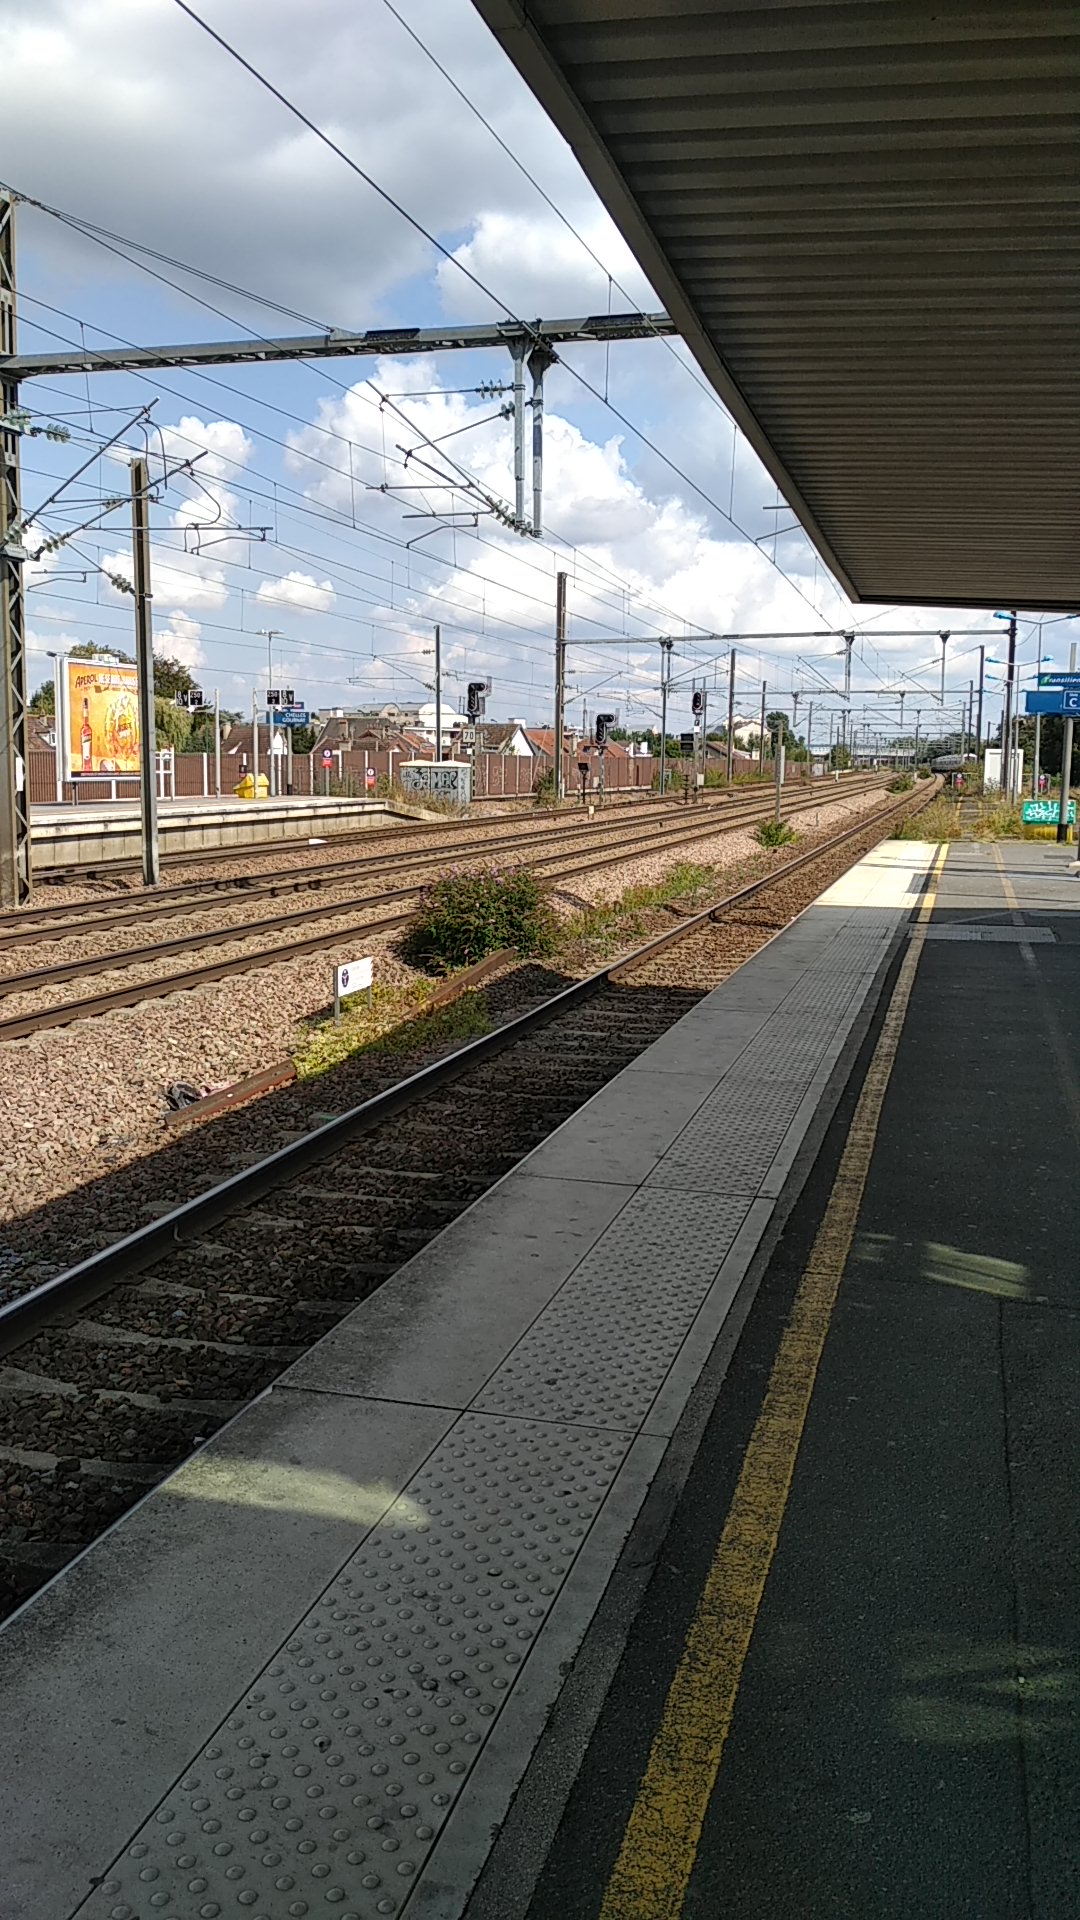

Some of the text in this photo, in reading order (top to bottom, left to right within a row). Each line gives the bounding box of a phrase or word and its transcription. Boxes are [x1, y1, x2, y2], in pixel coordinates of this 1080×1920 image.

[75, 673, 98, 688] APEROL
[1069, 698, 1078, 707] C
[464, 731, 474, 740] 70
